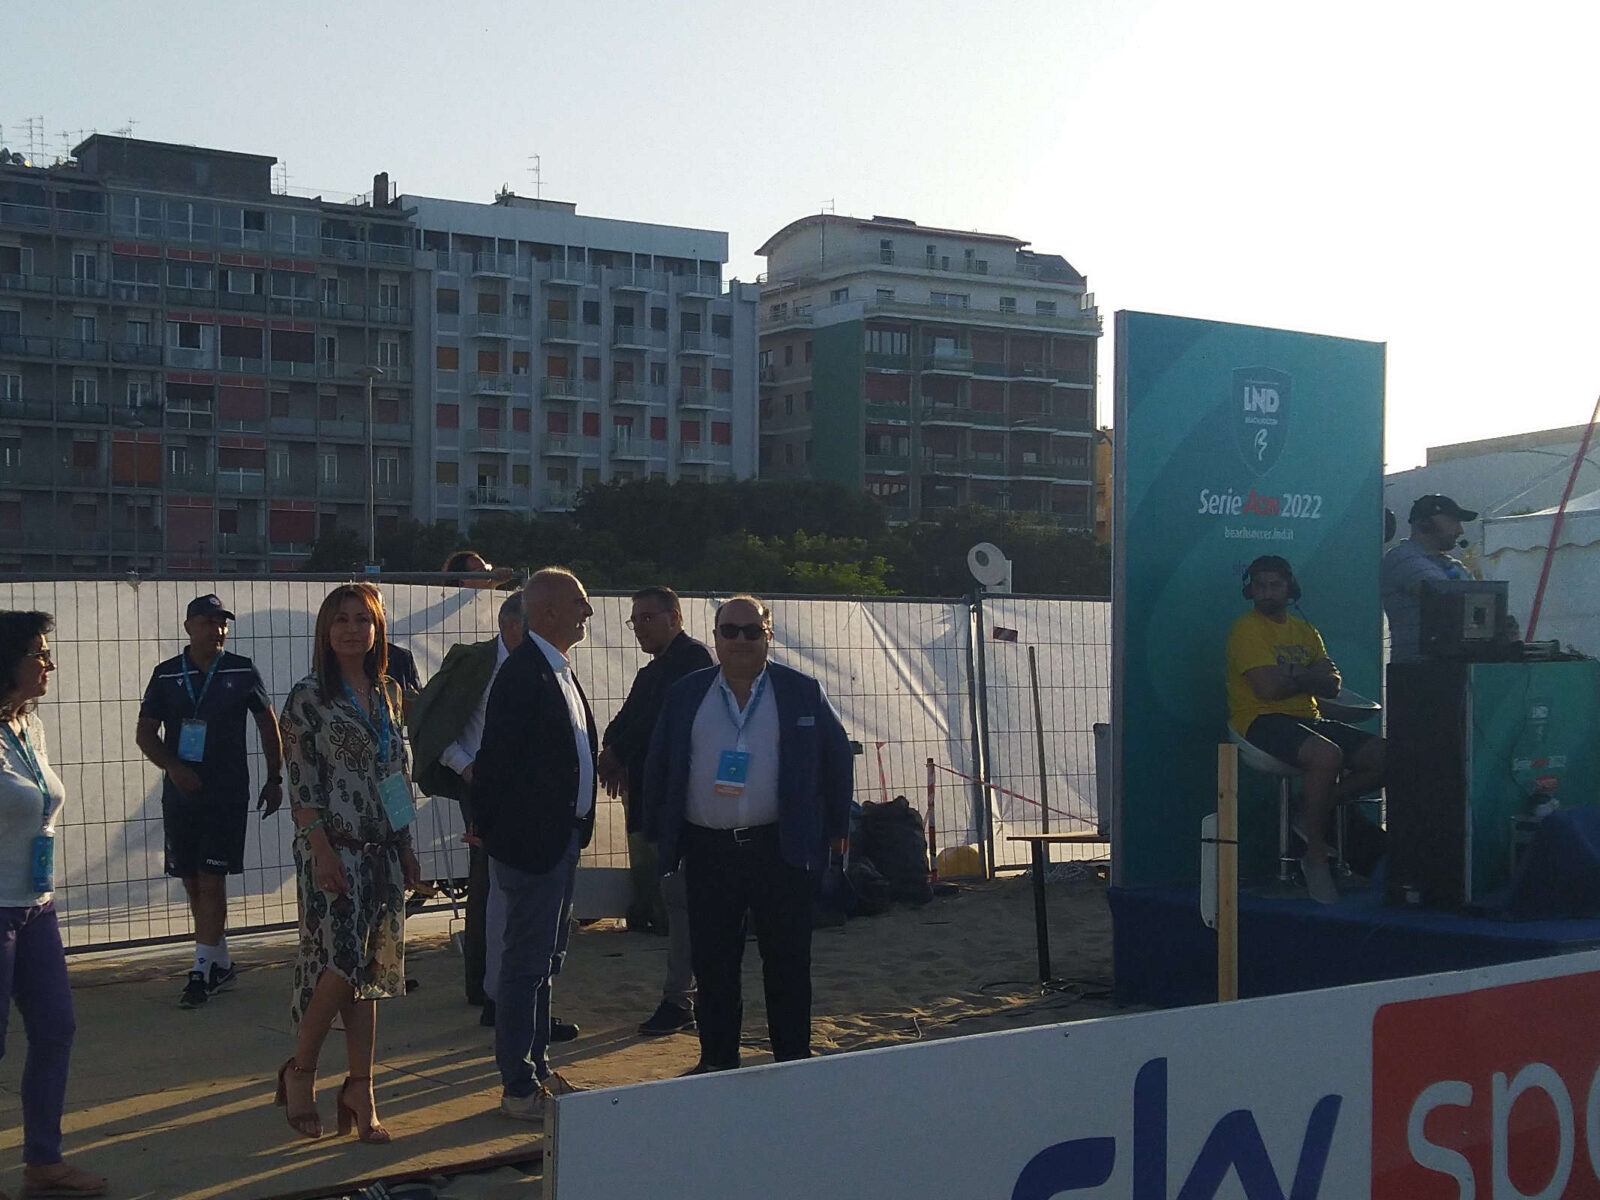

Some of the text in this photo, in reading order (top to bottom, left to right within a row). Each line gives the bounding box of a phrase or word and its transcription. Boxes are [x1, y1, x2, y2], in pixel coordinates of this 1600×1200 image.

[1244, 386, 1280, 415] LND
[1198, 488, 1242, 515] Serie
[1281, 493, 1322, 518] 2022
[1407, 1062, 1600, 1200] sp
